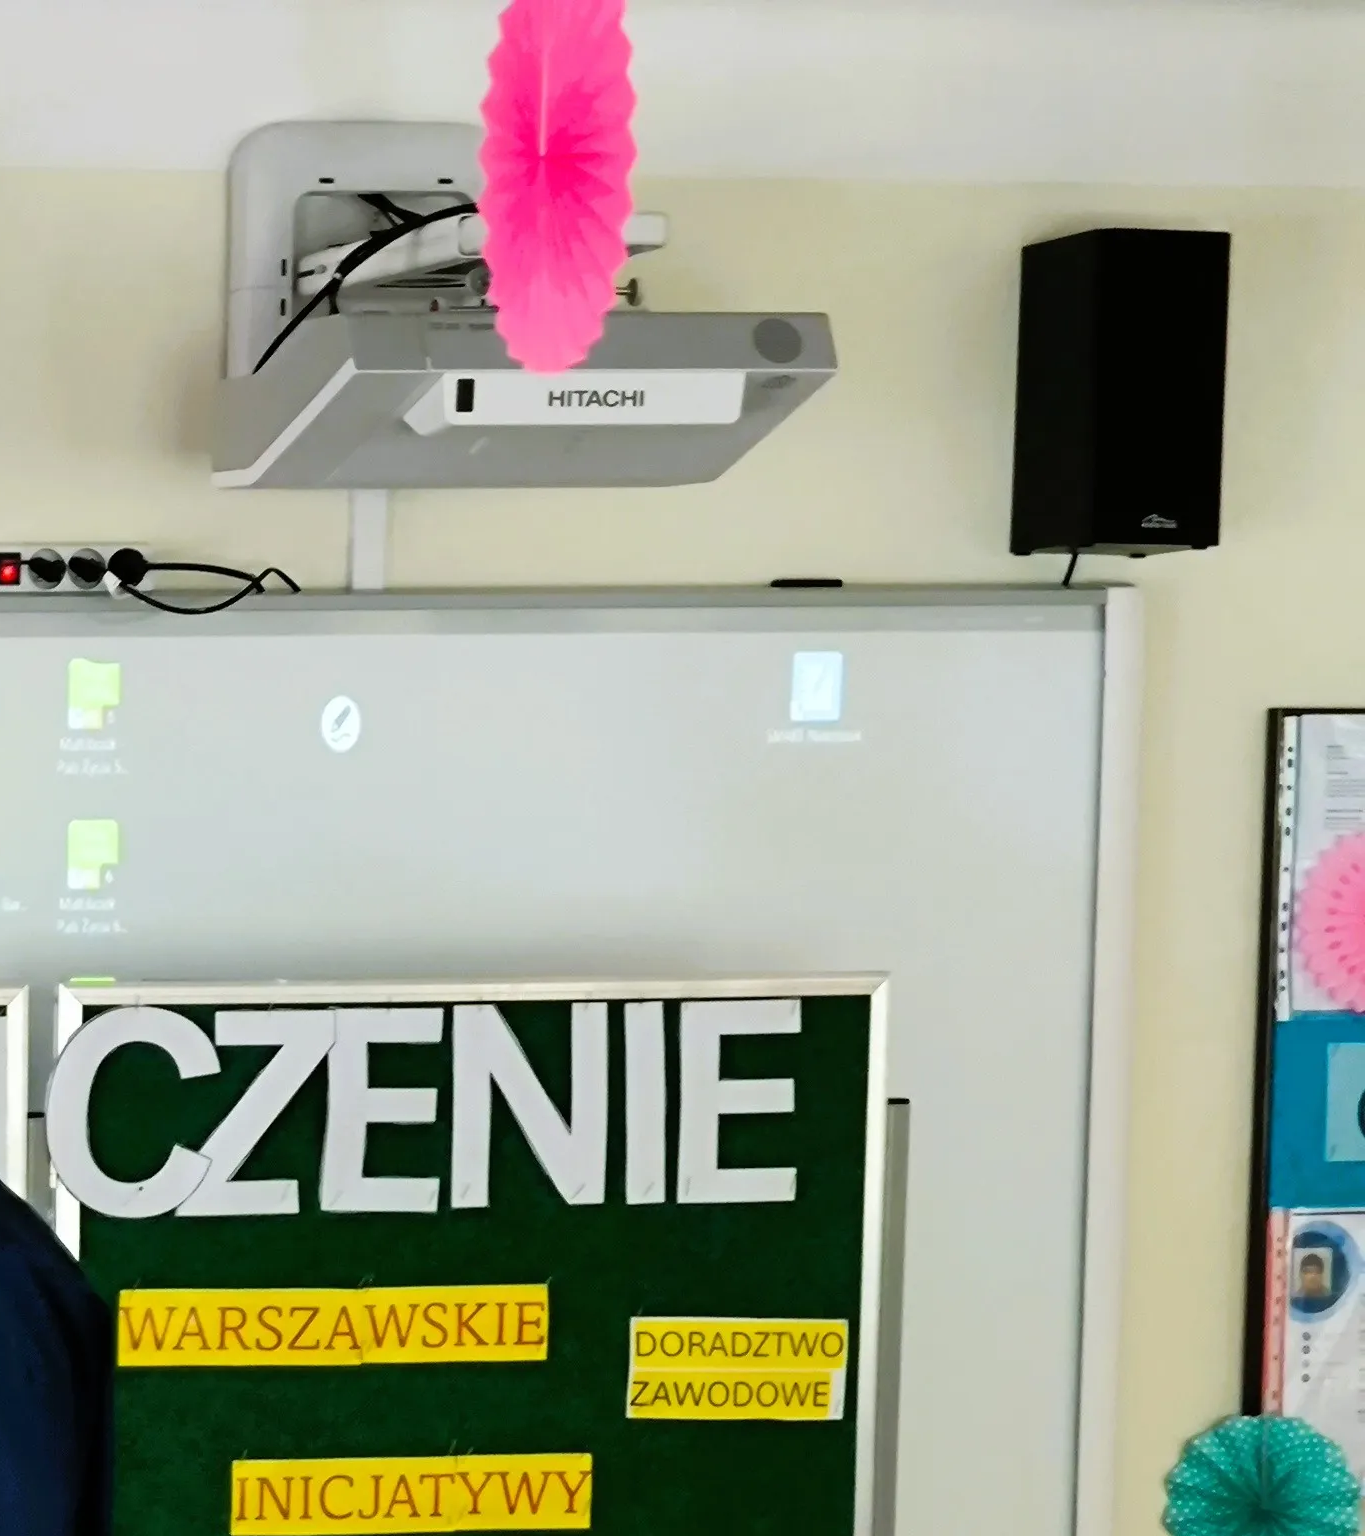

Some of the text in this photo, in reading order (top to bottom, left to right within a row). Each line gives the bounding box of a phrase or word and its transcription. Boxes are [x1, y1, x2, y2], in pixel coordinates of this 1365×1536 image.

[547, 390, 645, 408] HITACHI
[120, 1300, 546, 1351] WARSZAWSKIE
[634, 1329, 845, 1361] DORADZTWO
[629, 1379, 830, 1409] ZAWODOWE
[234, 1468, 591, 1523] INICJATYWY
